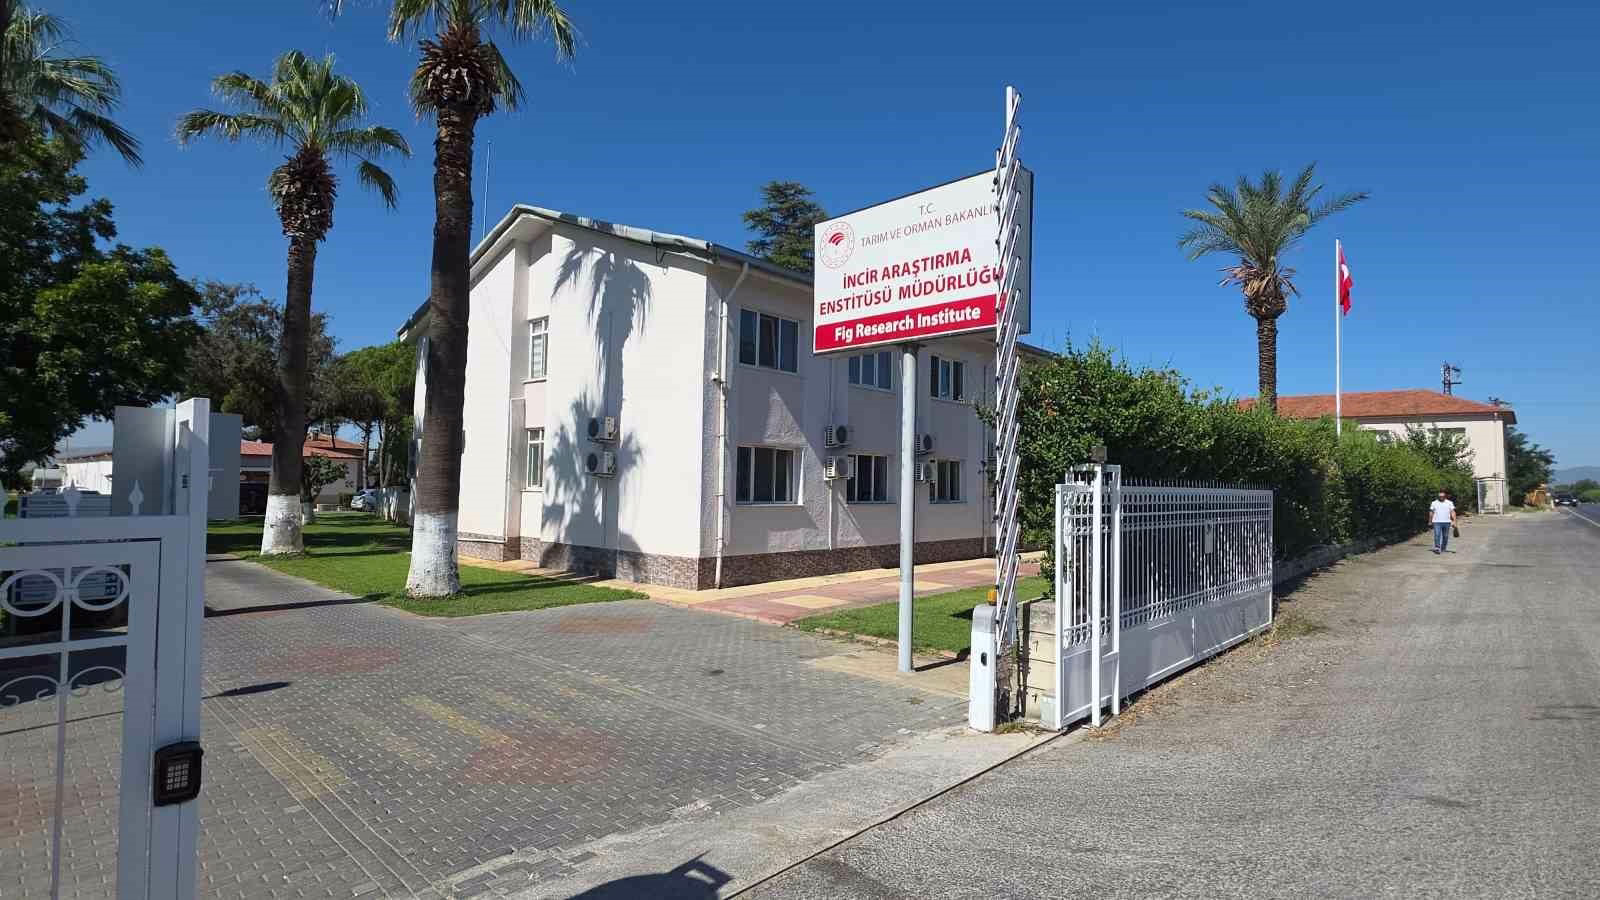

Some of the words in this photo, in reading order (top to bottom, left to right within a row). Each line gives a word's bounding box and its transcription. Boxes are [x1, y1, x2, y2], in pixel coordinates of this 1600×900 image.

[861, 231, 887, 248] TARIM
[890, 226, 903, 241] VE
[903, 217, 942, 237] ORMAN
[843, 267, 878, 289] İNCİR
[881, 247, 972, 281] ARAŞTIRMA
[819, 285, 892, 316] ENSTİTÜSÜ
[834, 326, 853, 343] Fig
[855, 315, 914, 338] Research
[917, 306, 981, 328] Institute
